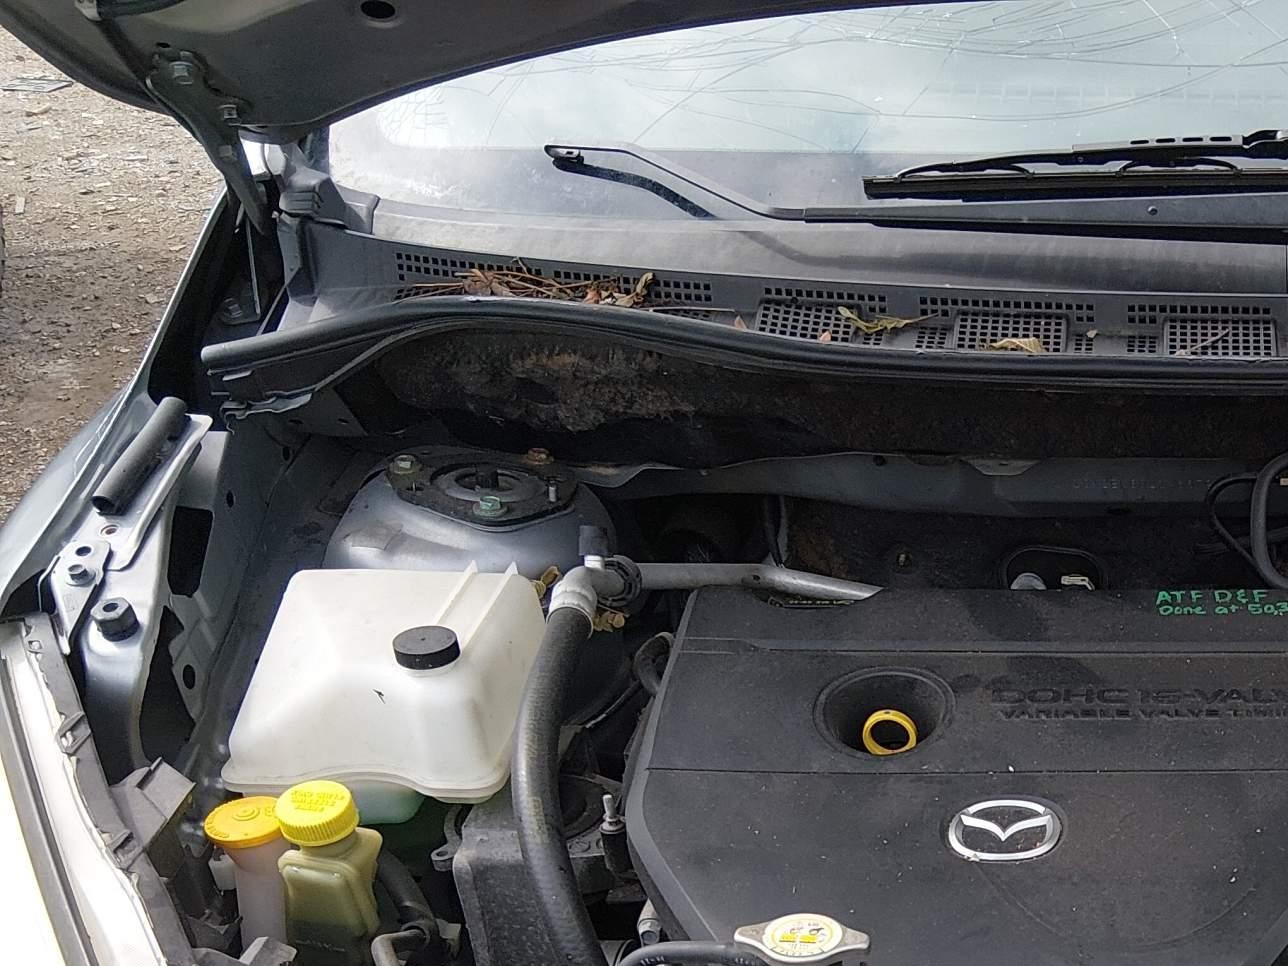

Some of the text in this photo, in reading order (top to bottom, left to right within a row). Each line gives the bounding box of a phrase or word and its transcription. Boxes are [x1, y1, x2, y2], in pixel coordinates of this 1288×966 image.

[1156, 590, 1203, 605] ATF
[1159, 605, 1207, 616] Done
[1215, 604, 1240, 614] at
[991, 688, 1130, 705] DOHC
[999, 708, 1131, 720] VARIABLE
[1138, 708, 1220, 720] VALVE
